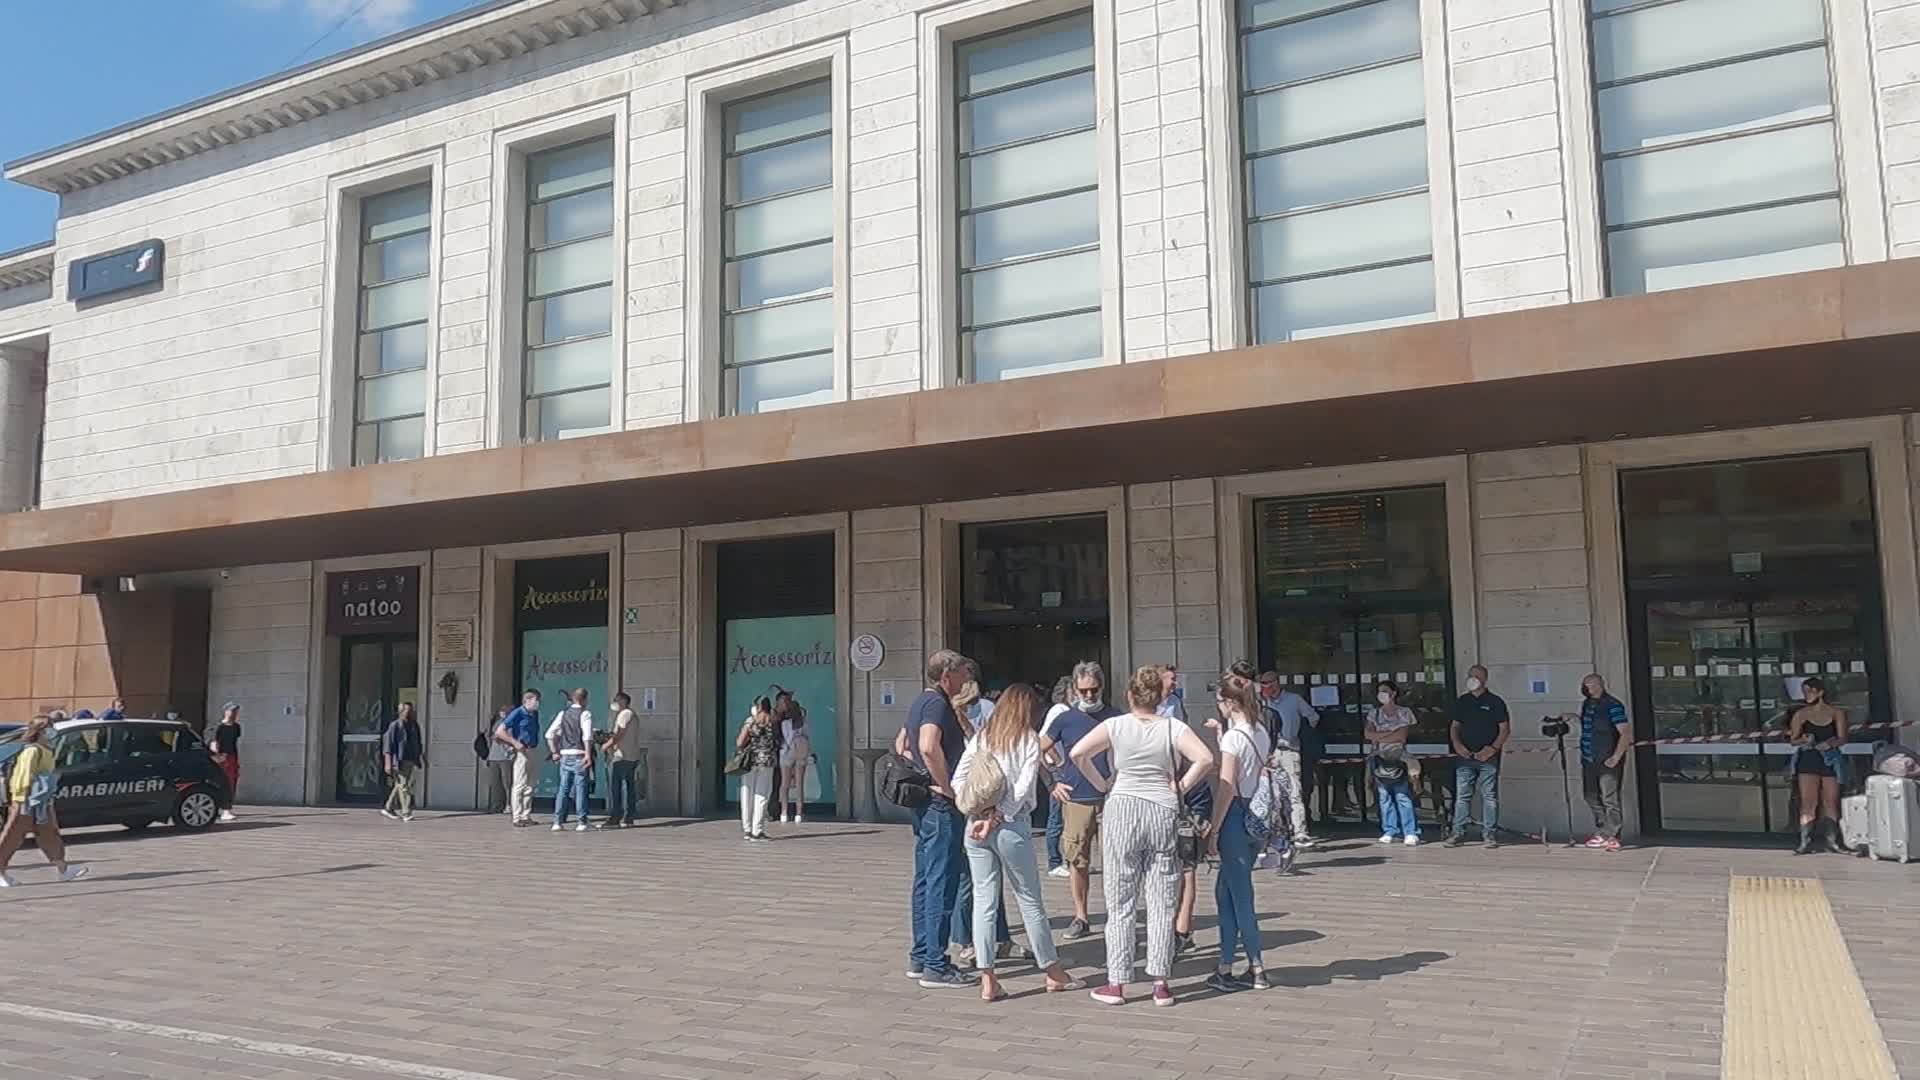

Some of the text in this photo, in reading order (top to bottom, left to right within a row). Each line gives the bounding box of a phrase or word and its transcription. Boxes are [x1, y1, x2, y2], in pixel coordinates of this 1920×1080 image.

[344, 598, 402, 617] natoo
[526, 651, 608, 681] Accessoriz
[53, 779, 166, 799] ARABINIERI
